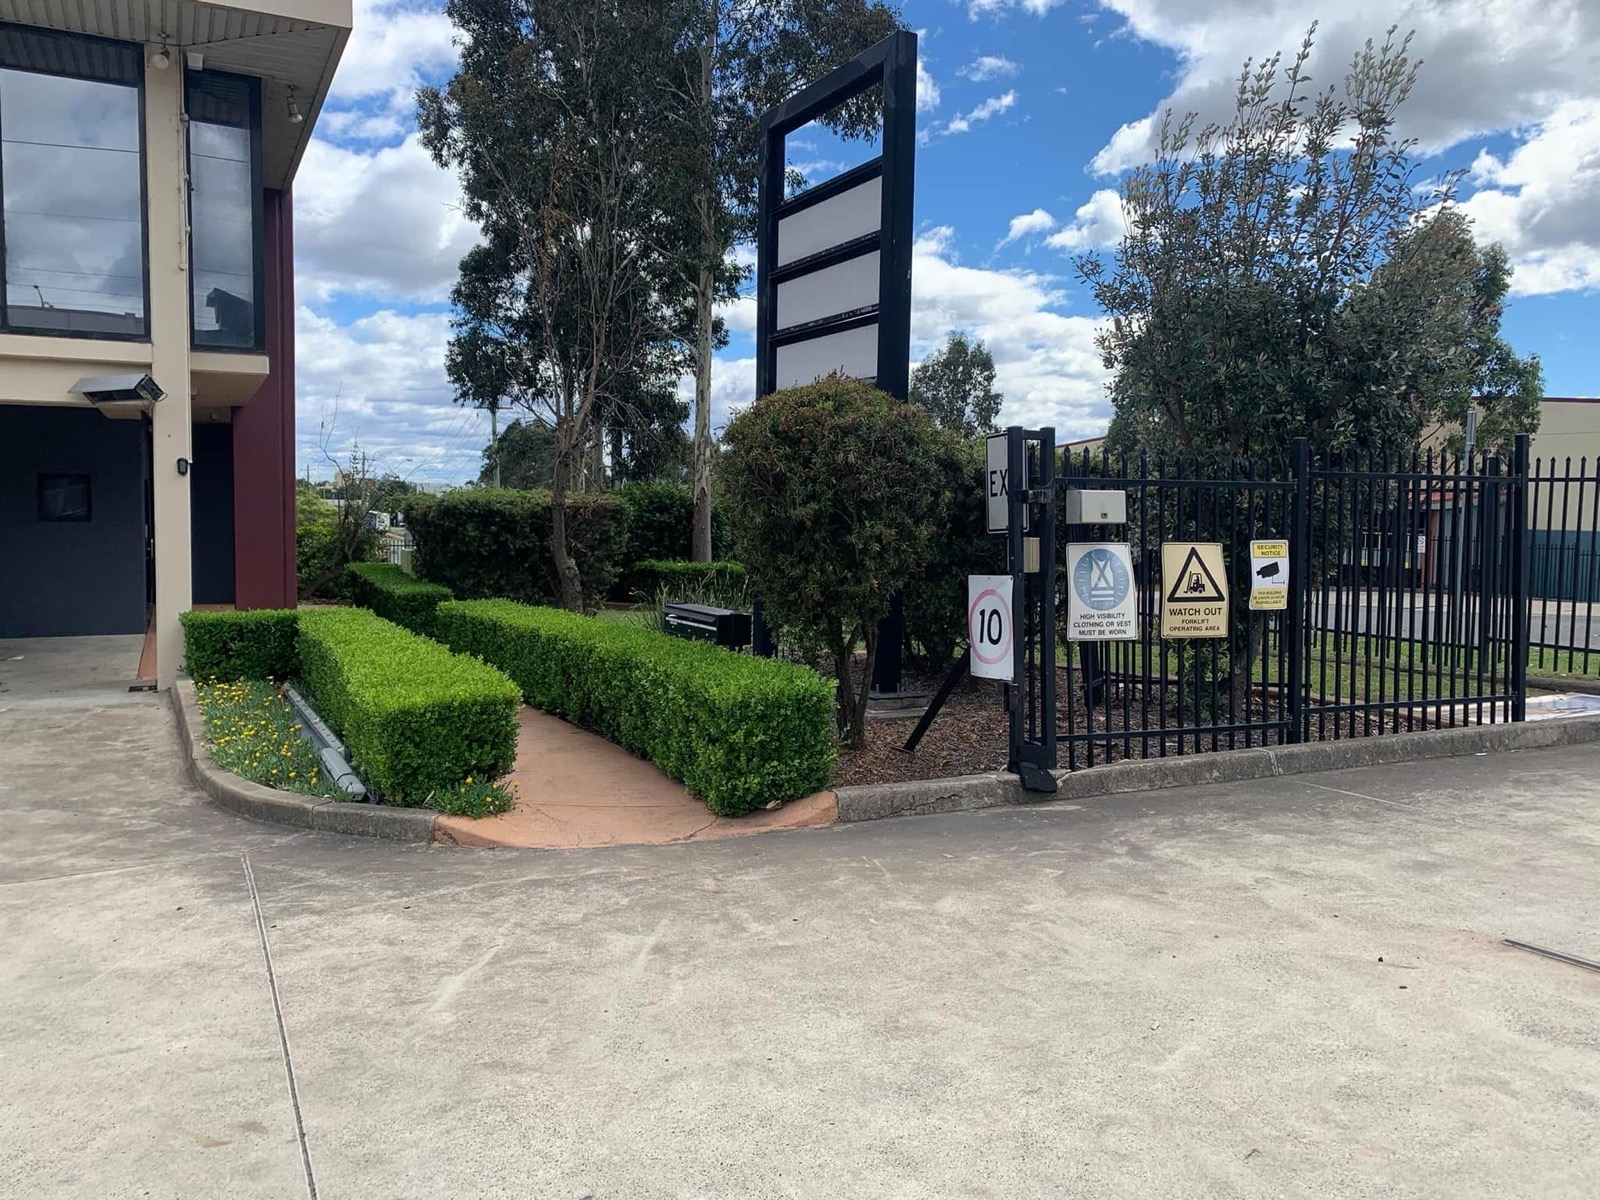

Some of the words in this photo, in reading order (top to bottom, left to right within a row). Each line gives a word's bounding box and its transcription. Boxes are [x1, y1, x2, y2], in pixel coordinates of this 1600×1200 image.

[990, 469, 1008, 497] EX
[1169, 608, 1200, 616] WATCH
[979, 608, 1002, 645] 10
